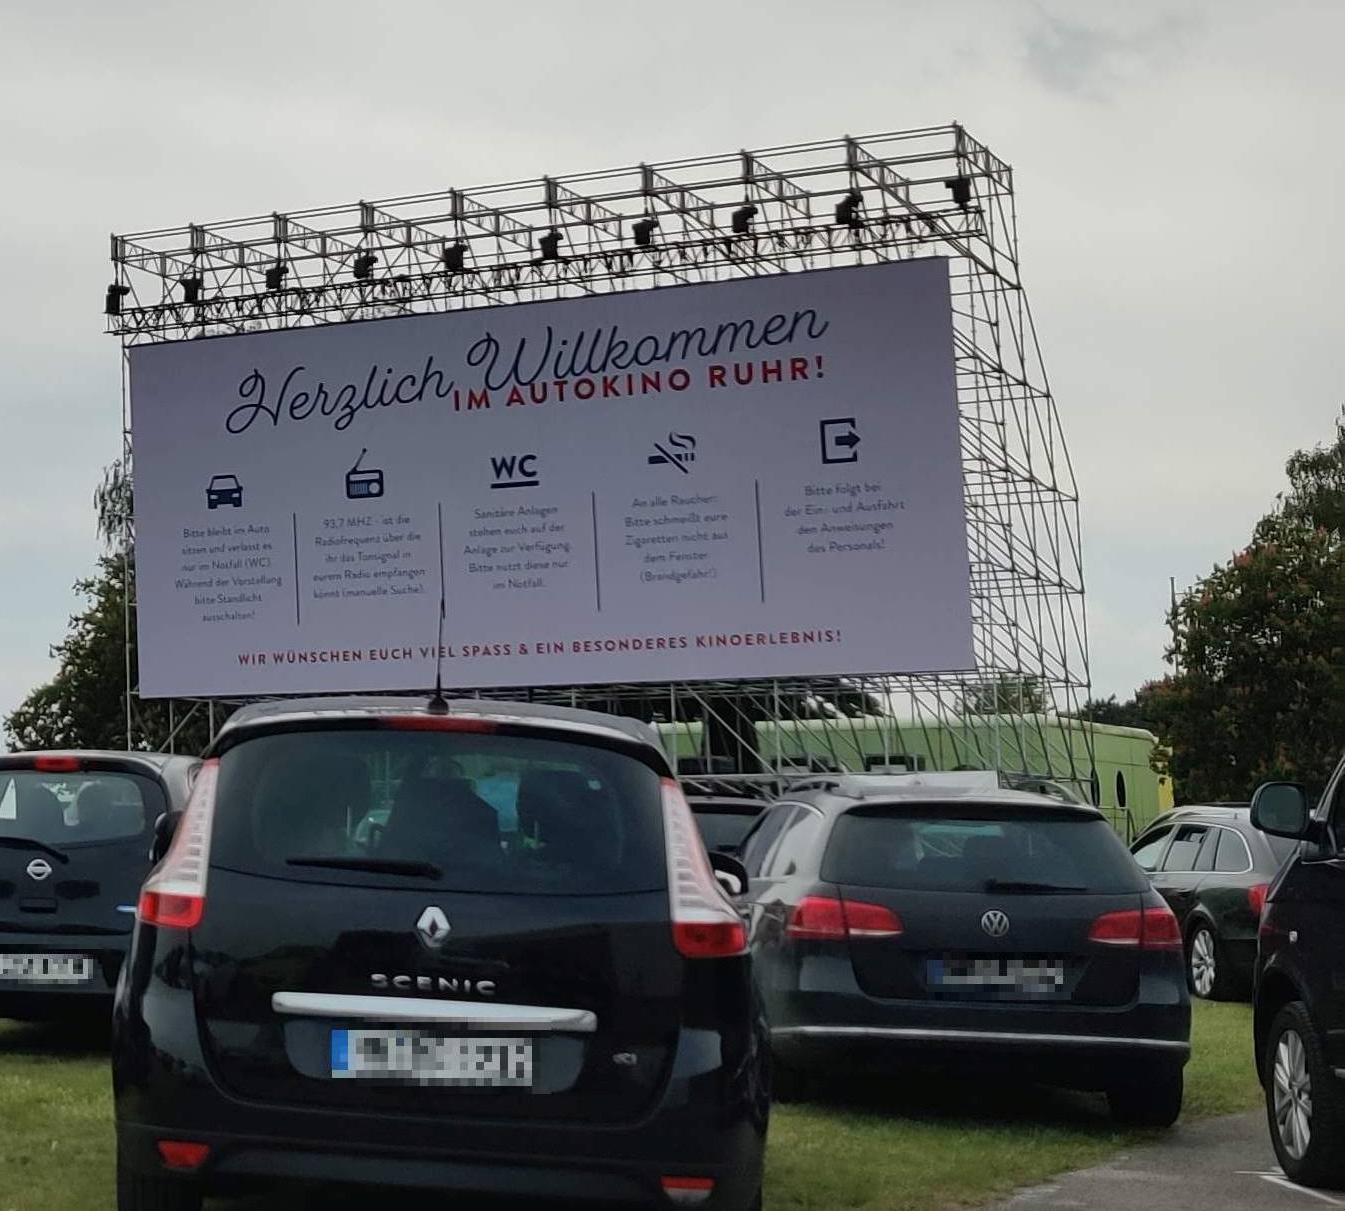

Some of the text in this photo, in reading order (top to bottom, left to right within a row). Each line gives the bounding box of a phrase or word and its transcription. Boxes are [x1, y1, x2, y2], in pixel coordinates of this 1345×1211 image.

[226, 308, 829, 434] Herzlich Willkommen
[454, 355, 824, 411] IM AUTOKINO RUHR!
[490, 454, 538, 480] WC
[183, 528, 206, 538] Bitte
[248, 524, 270, 534] Auto
[209, 544, 225, 554] und
[212, 559, 242, 569] Notfall
[238, 630, 842, 666] WIR WÜNSCHEN EUCH VIEL SPASS & EIN BESONDERES KINOERLEBNIS!
[371, 973, 496, 995] SCENIC
